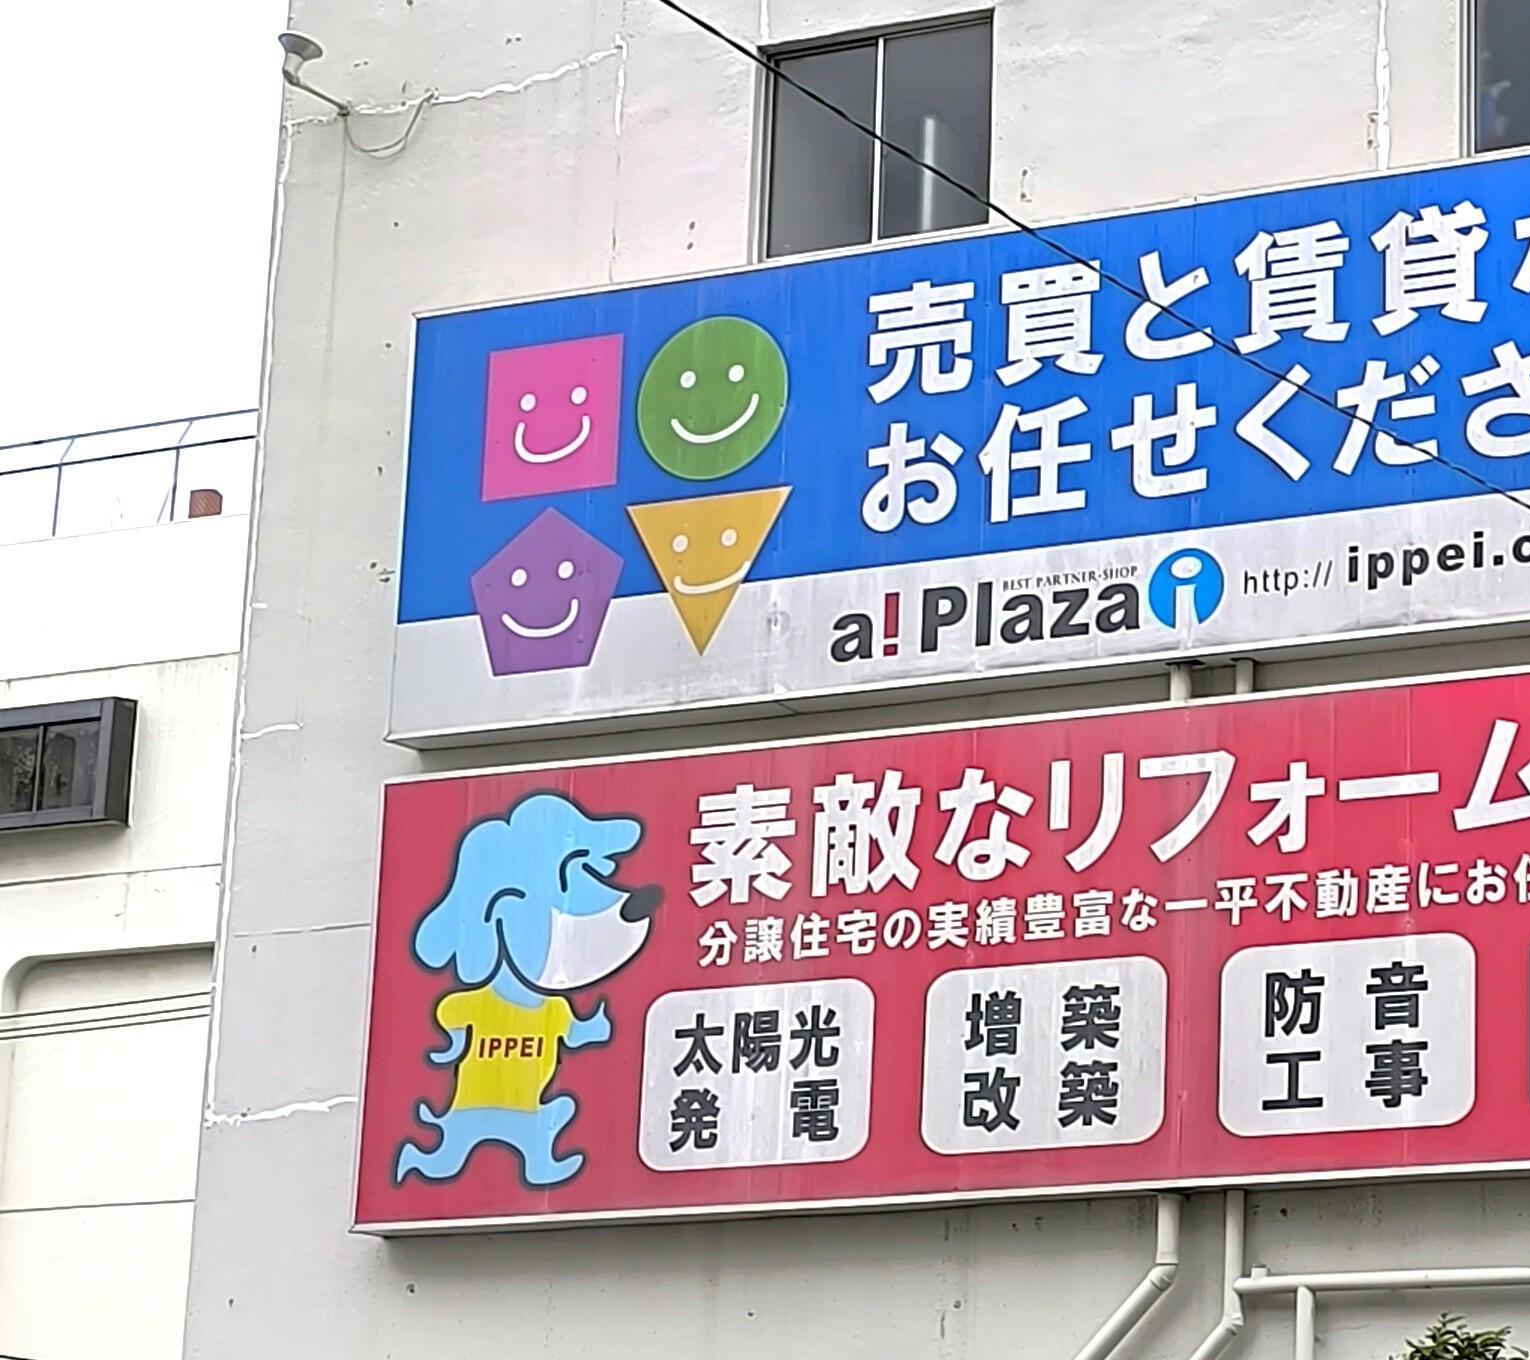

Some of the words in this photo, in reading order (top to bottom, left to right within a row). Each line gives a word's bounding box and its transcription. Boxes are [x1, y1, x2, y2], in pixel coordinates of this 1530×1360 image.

[1003, 578, 1031, 592] BEST
[478, 1036, 544, 1059] IPPEI
[673, 1004, 841, 1077] 太陽光
